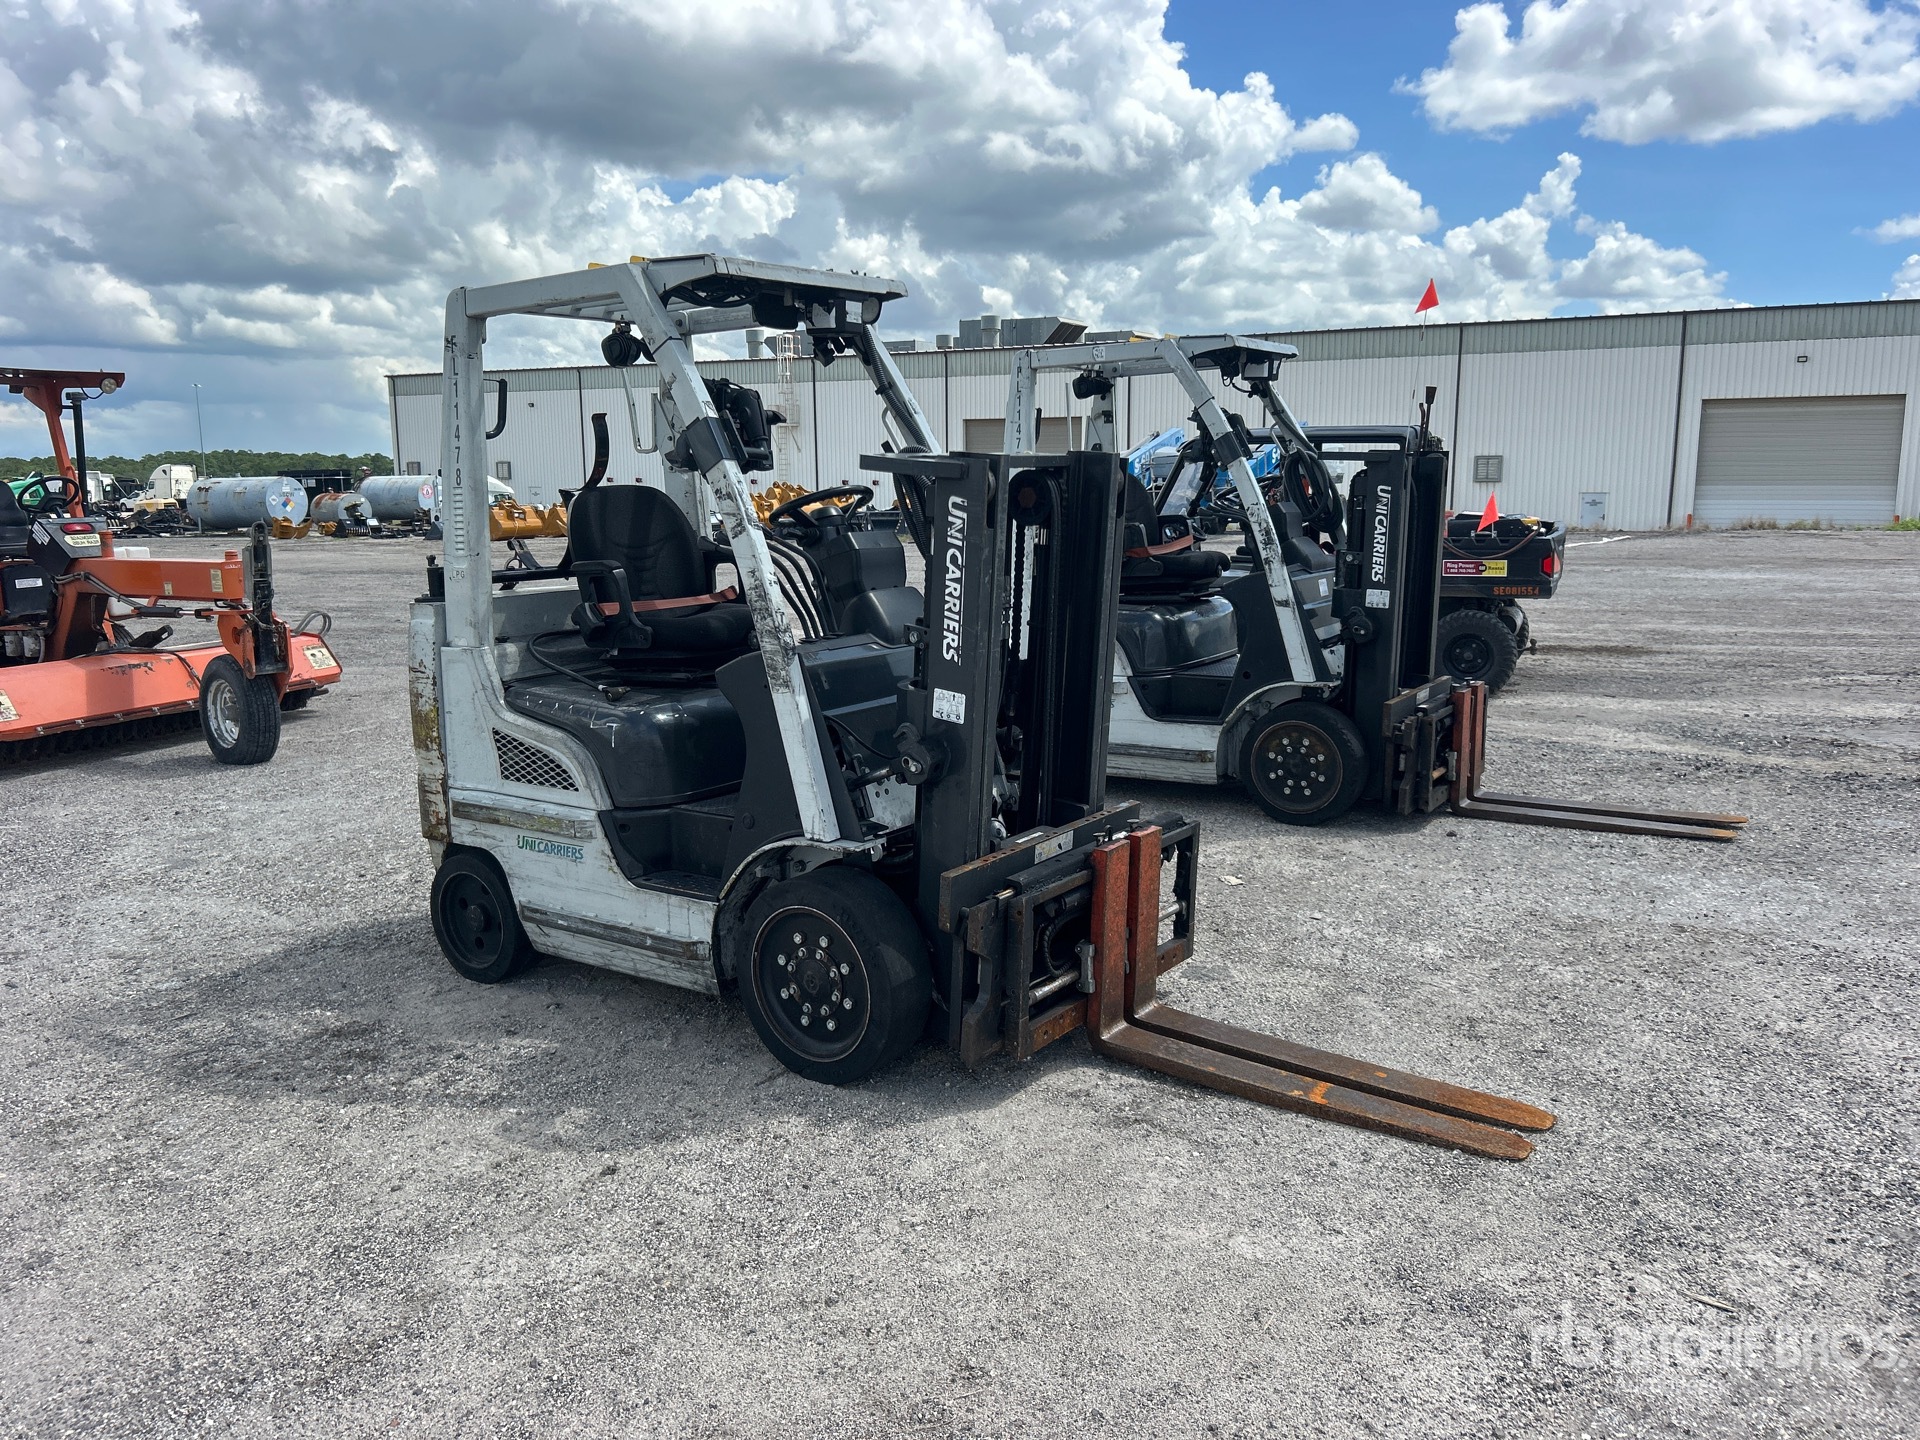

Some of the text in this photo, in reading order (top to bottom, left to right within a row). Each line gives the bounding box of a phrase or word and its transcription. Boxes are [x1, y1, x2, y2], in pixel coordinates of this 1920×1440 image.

[1371, 484, 1392, 584] UNICARRIERS
[451, 570, 465, 579] LPG
[942, 495, 968, 666] UNICARRIERS
[1493, 586, 1540, 596] SE081554
[516, 834, 585, 860] UNICARRIERS
